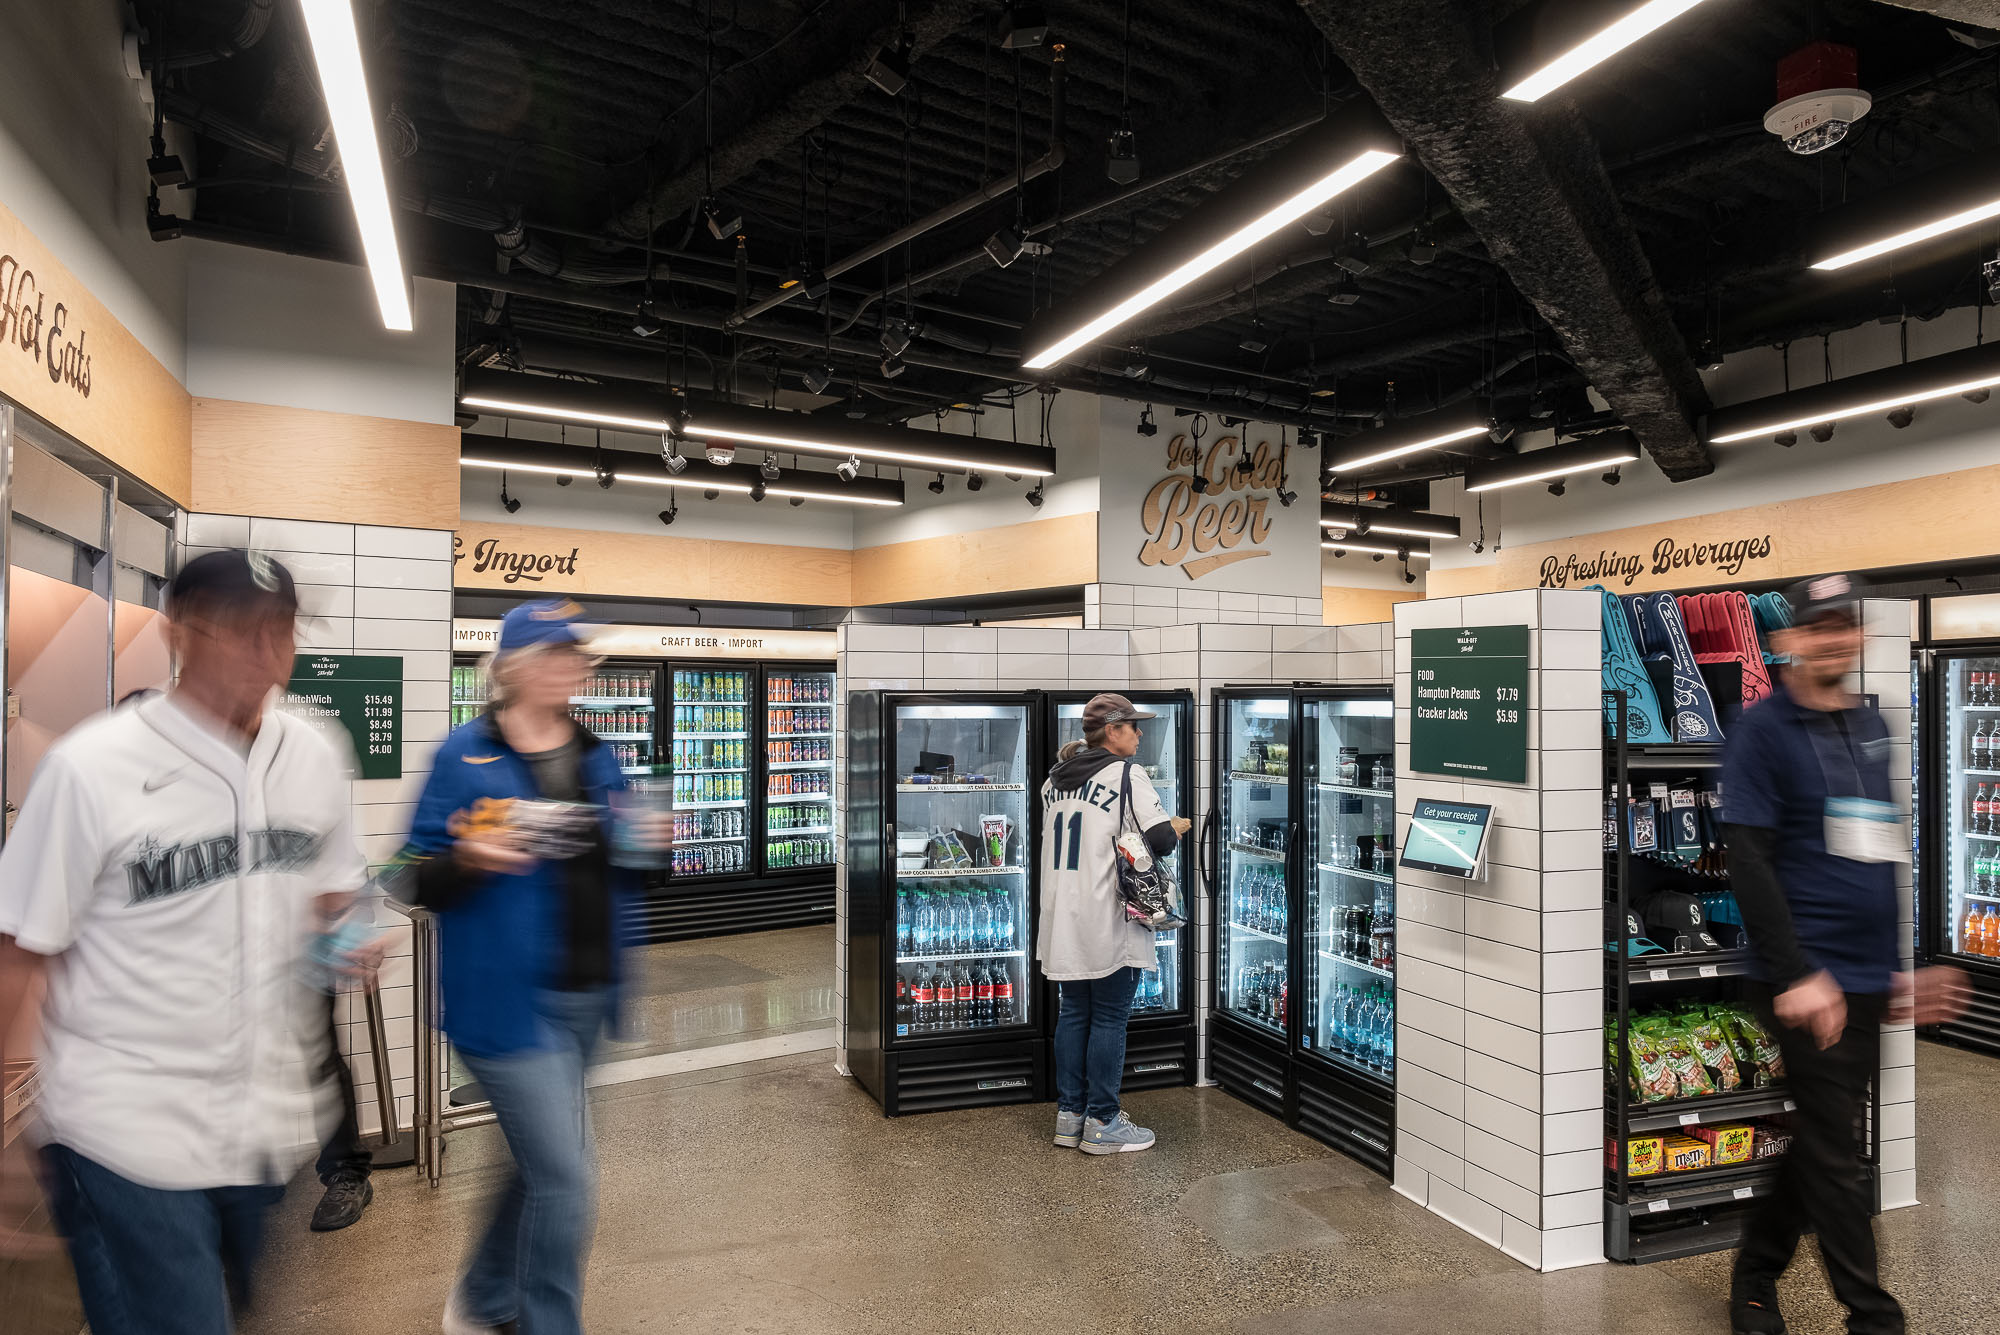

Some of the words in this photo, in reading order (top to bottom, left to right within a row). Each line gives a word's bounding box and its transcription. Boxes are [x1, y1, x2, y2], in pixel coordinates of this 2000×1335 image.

[1794, 115, 1817, 131] FIRE
[0, 255, 44, 364] Hot
[47, 303, 91, 399] Eats
[1167, 434, 1203, 471] Ice
[1202, 436, 1290, 496] Cold
[1138, 474, 1272, 566] Beer
[473, 539, 579, 583] Import
[1539, 551, 1645, 588] Refreshing
[1651, 535, 1771, 576] Beverages
[455, 630, 499, 641] IMPORT
[1740, 602, 1759, 670] MARINERS
[661, 637, 691, 647] CRAFT
[695, 638, 718, 647] BEER
[728, 639, 763, 648] IMPORT
[1663, 610, 1694, 675] MARINERS
[1417, 670, 1434, 681] FOOD
[287, 694, 332, 704] MitchWich
[364, 694, 393, 705] $15.49
[1418, 686, 1449, 701] Hampton
[1450, 687, 1481, 700] Peanuts
[1497, 687, 1518, 702] $7.79
[309, 708, 340, 717] Cheese
[364, 707, 393, 717] $11.99
[1417, 706, 1447, 720] Cracker
[1448, 707, 1468, 720] Jacks
[1496, 708, 1518, 723] $5.99
[369, 720, 393, 730] $8.49
[369, 732, 393, 742] $8.79
[369, 744, 392, 755] $4.00
[1424, 807, 1437, 816] Get
[1436, 809, 1453, 818] your
[1453, 811, 1478, 822] receipt
[1053, 811, 1083, 871] 11
[1727, 1136, 1743, 1145] SOUR
[1635, 1147, 1651, 1156] SOUR
[1726, 1142, 1743, 1153] PATCH
[1634, 1153, 1652, 1164] PATCH
